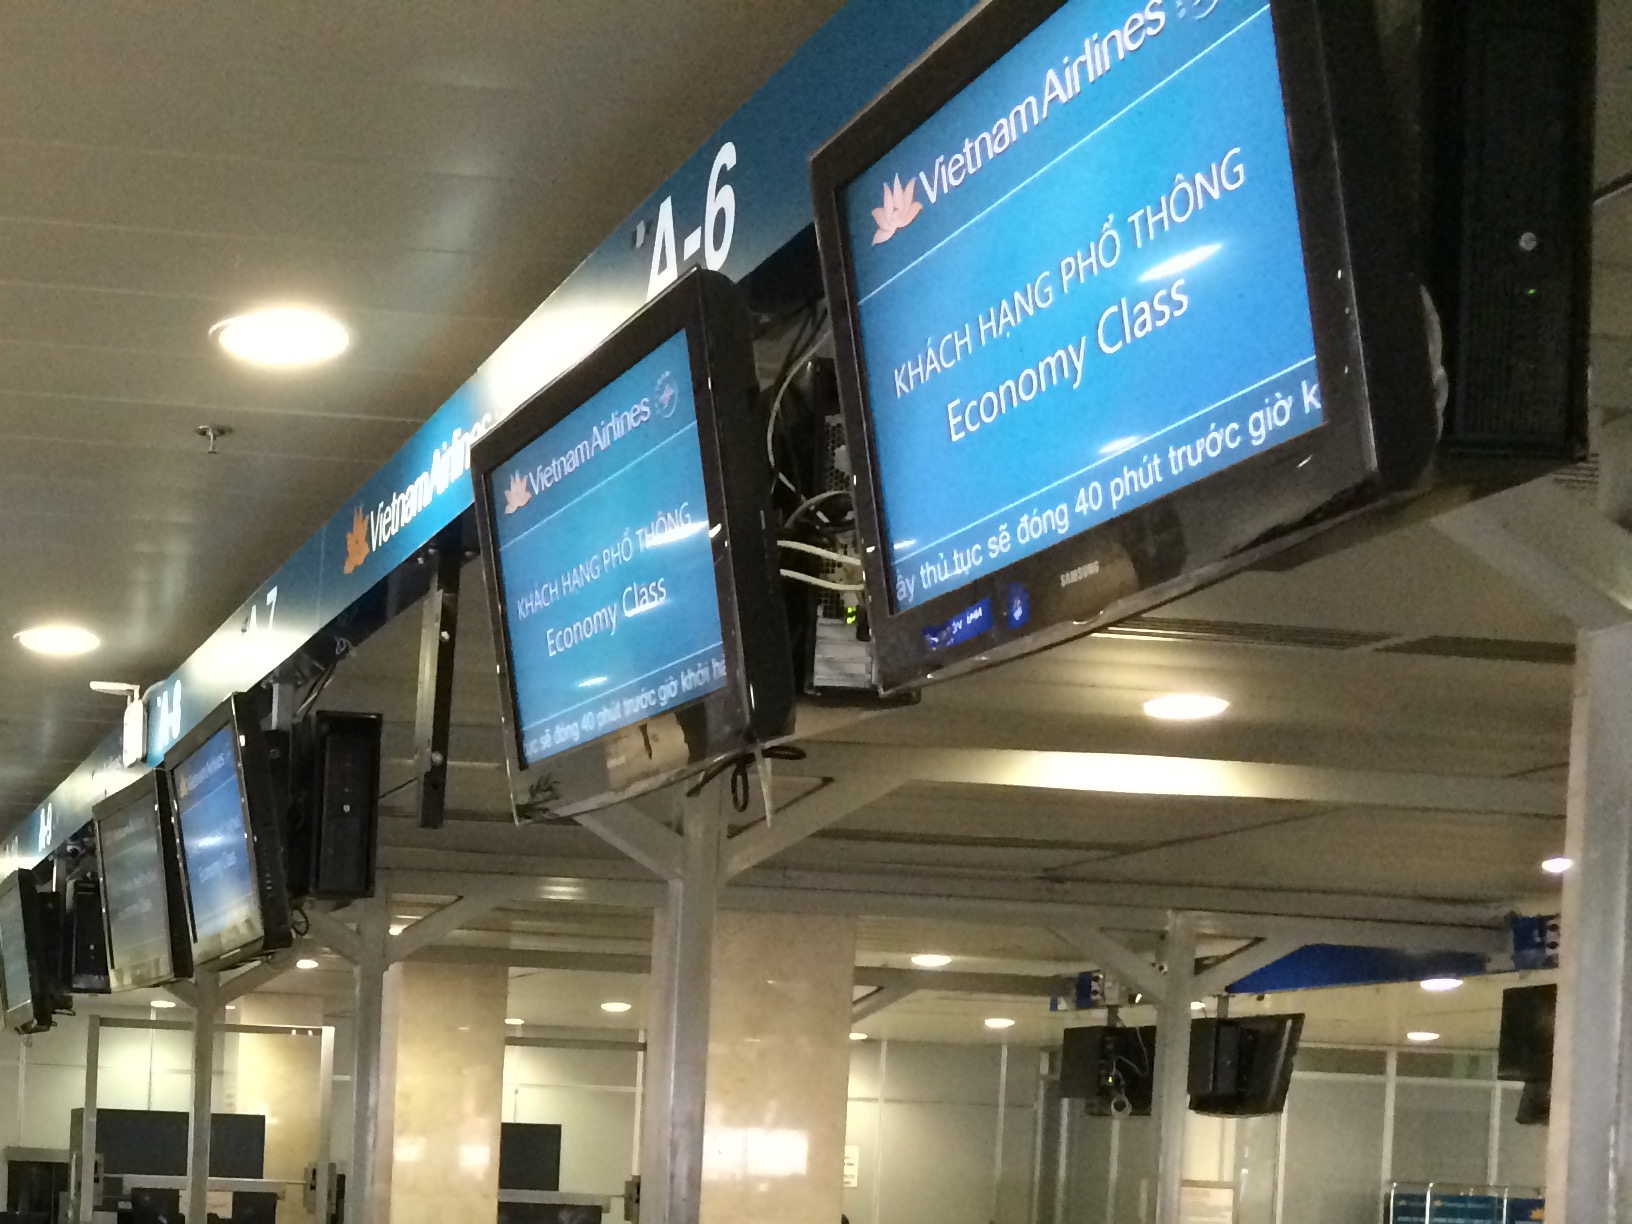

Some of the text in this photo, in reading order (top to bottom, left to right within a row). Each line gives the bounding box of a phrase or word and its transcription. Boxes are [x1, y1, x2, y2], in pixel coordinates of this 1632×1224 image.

[894, 147, 1246, 399] KHÁCH HẠNG PHỔ THÔNG
[947, 278, 1189, 442] Economy Class
[988, 523, 1011, 558] sẽ
[1017, 503, 1069, 545] đóng
[1075, 481, 1103, 516] 40
[1110, 453, 1163, 510] phút
[1168, 422, 1241, 475] trước
[1249, 392, 1293, 446] giờ
[517, 580, 559, 621] KHÁCH
[602, 526, 633, 573] PHỔ
[546, 577, 667, 657] Economy Class
[1060, 560, 1100, 588] SAMSUNG
[581, 711, 596, 733] 40
